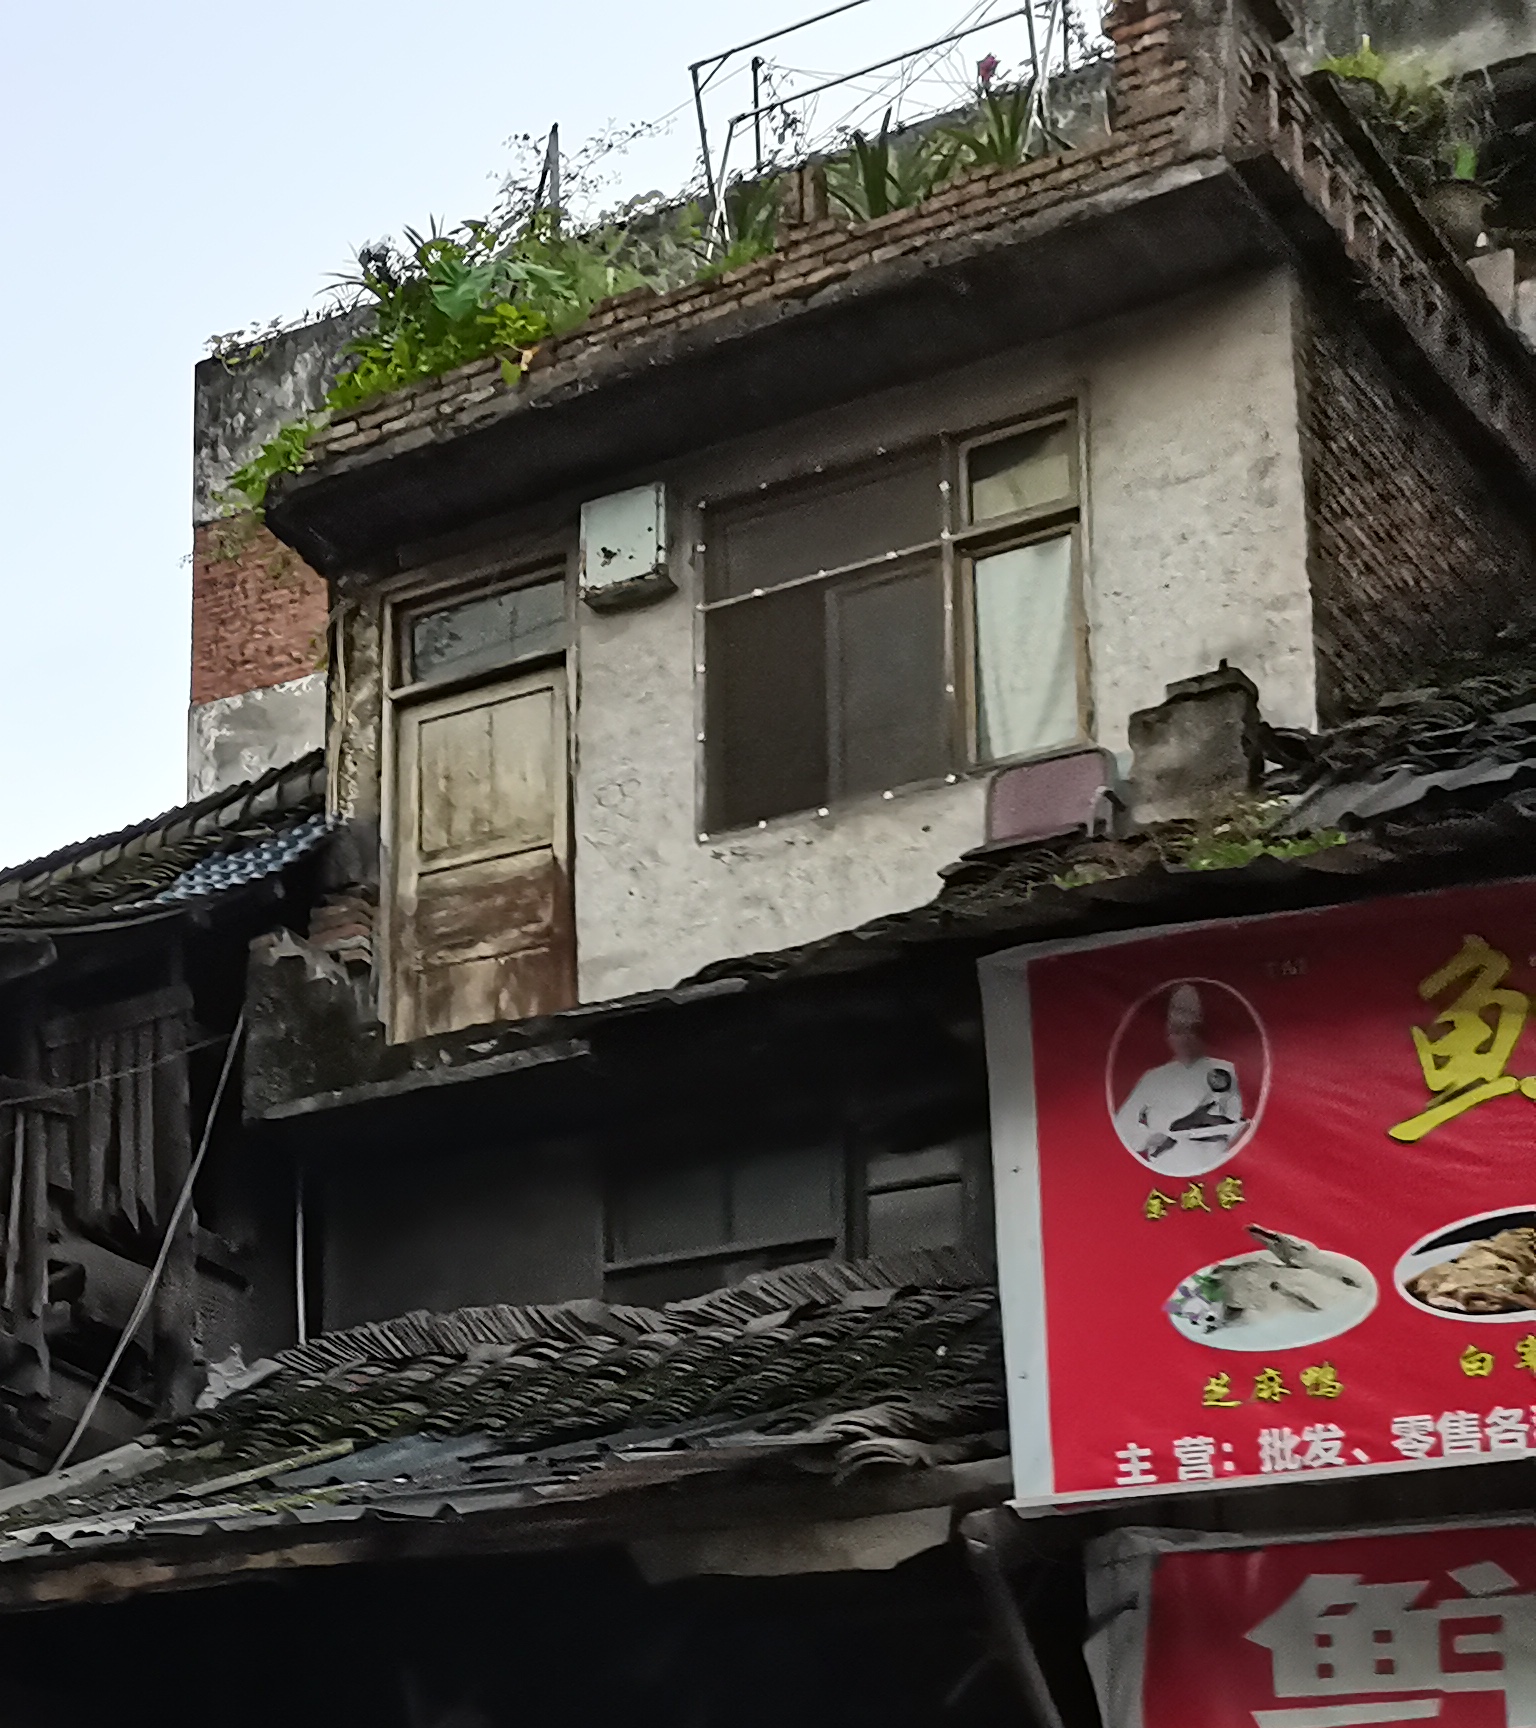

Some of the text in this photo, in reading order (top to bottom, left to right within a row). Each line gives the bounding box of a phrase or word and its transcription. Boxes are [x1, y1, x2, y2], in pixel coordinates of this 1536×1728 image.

[1116, 1404, 1536, 1485] 主营：批发、零售各
